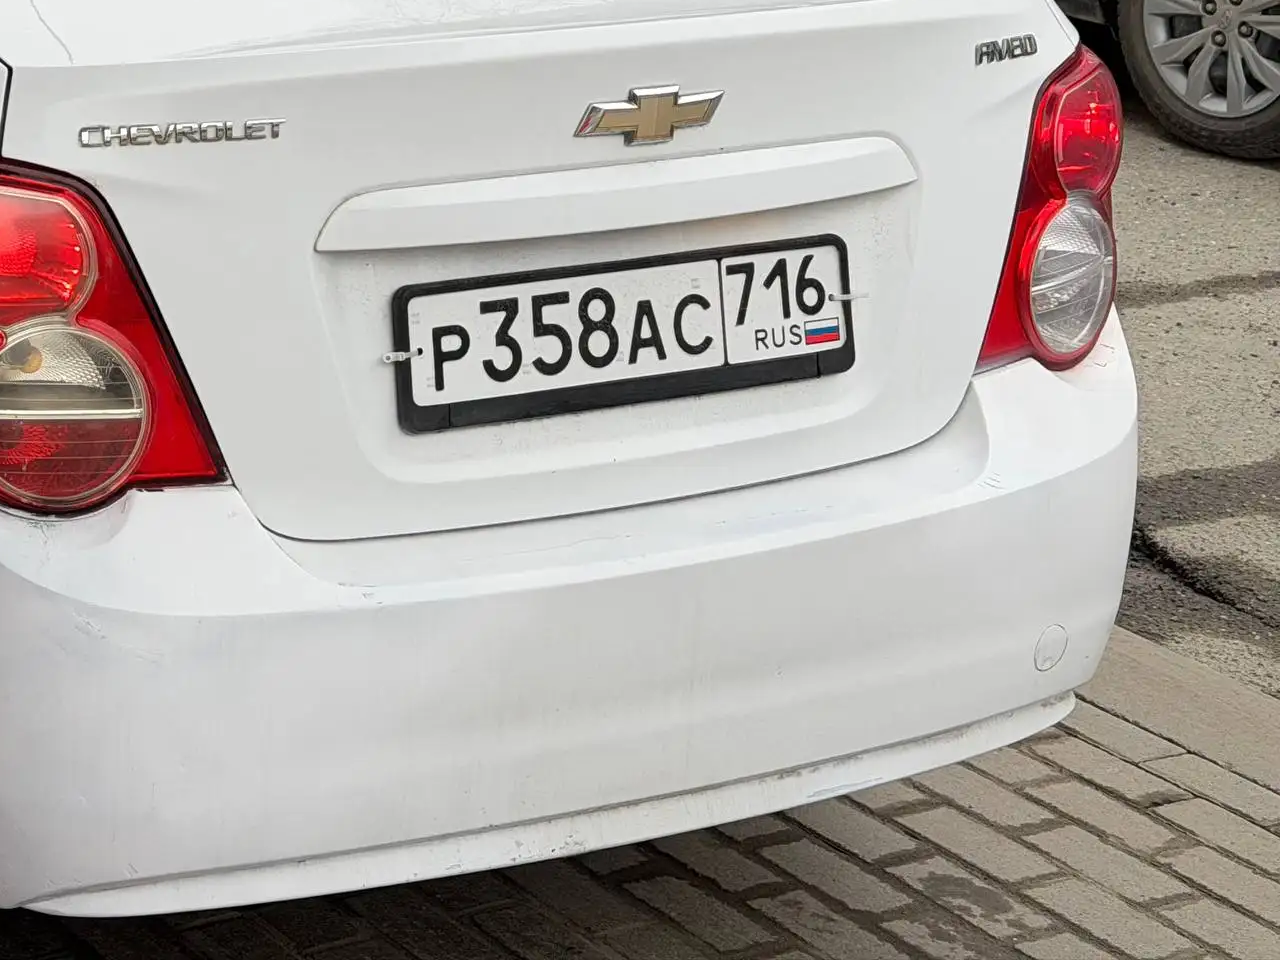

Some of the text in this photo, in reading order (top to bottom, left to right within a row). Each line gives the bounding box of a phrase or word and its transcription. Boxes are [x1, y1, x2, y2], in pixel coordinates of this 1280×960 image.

[975, 34, 1038, 66] AVEO
[78, 117, 287, 148] CHEVROLET
[431, 254, 826, 391] Р358АС 716
[754, 324, 803, 351] RUS
